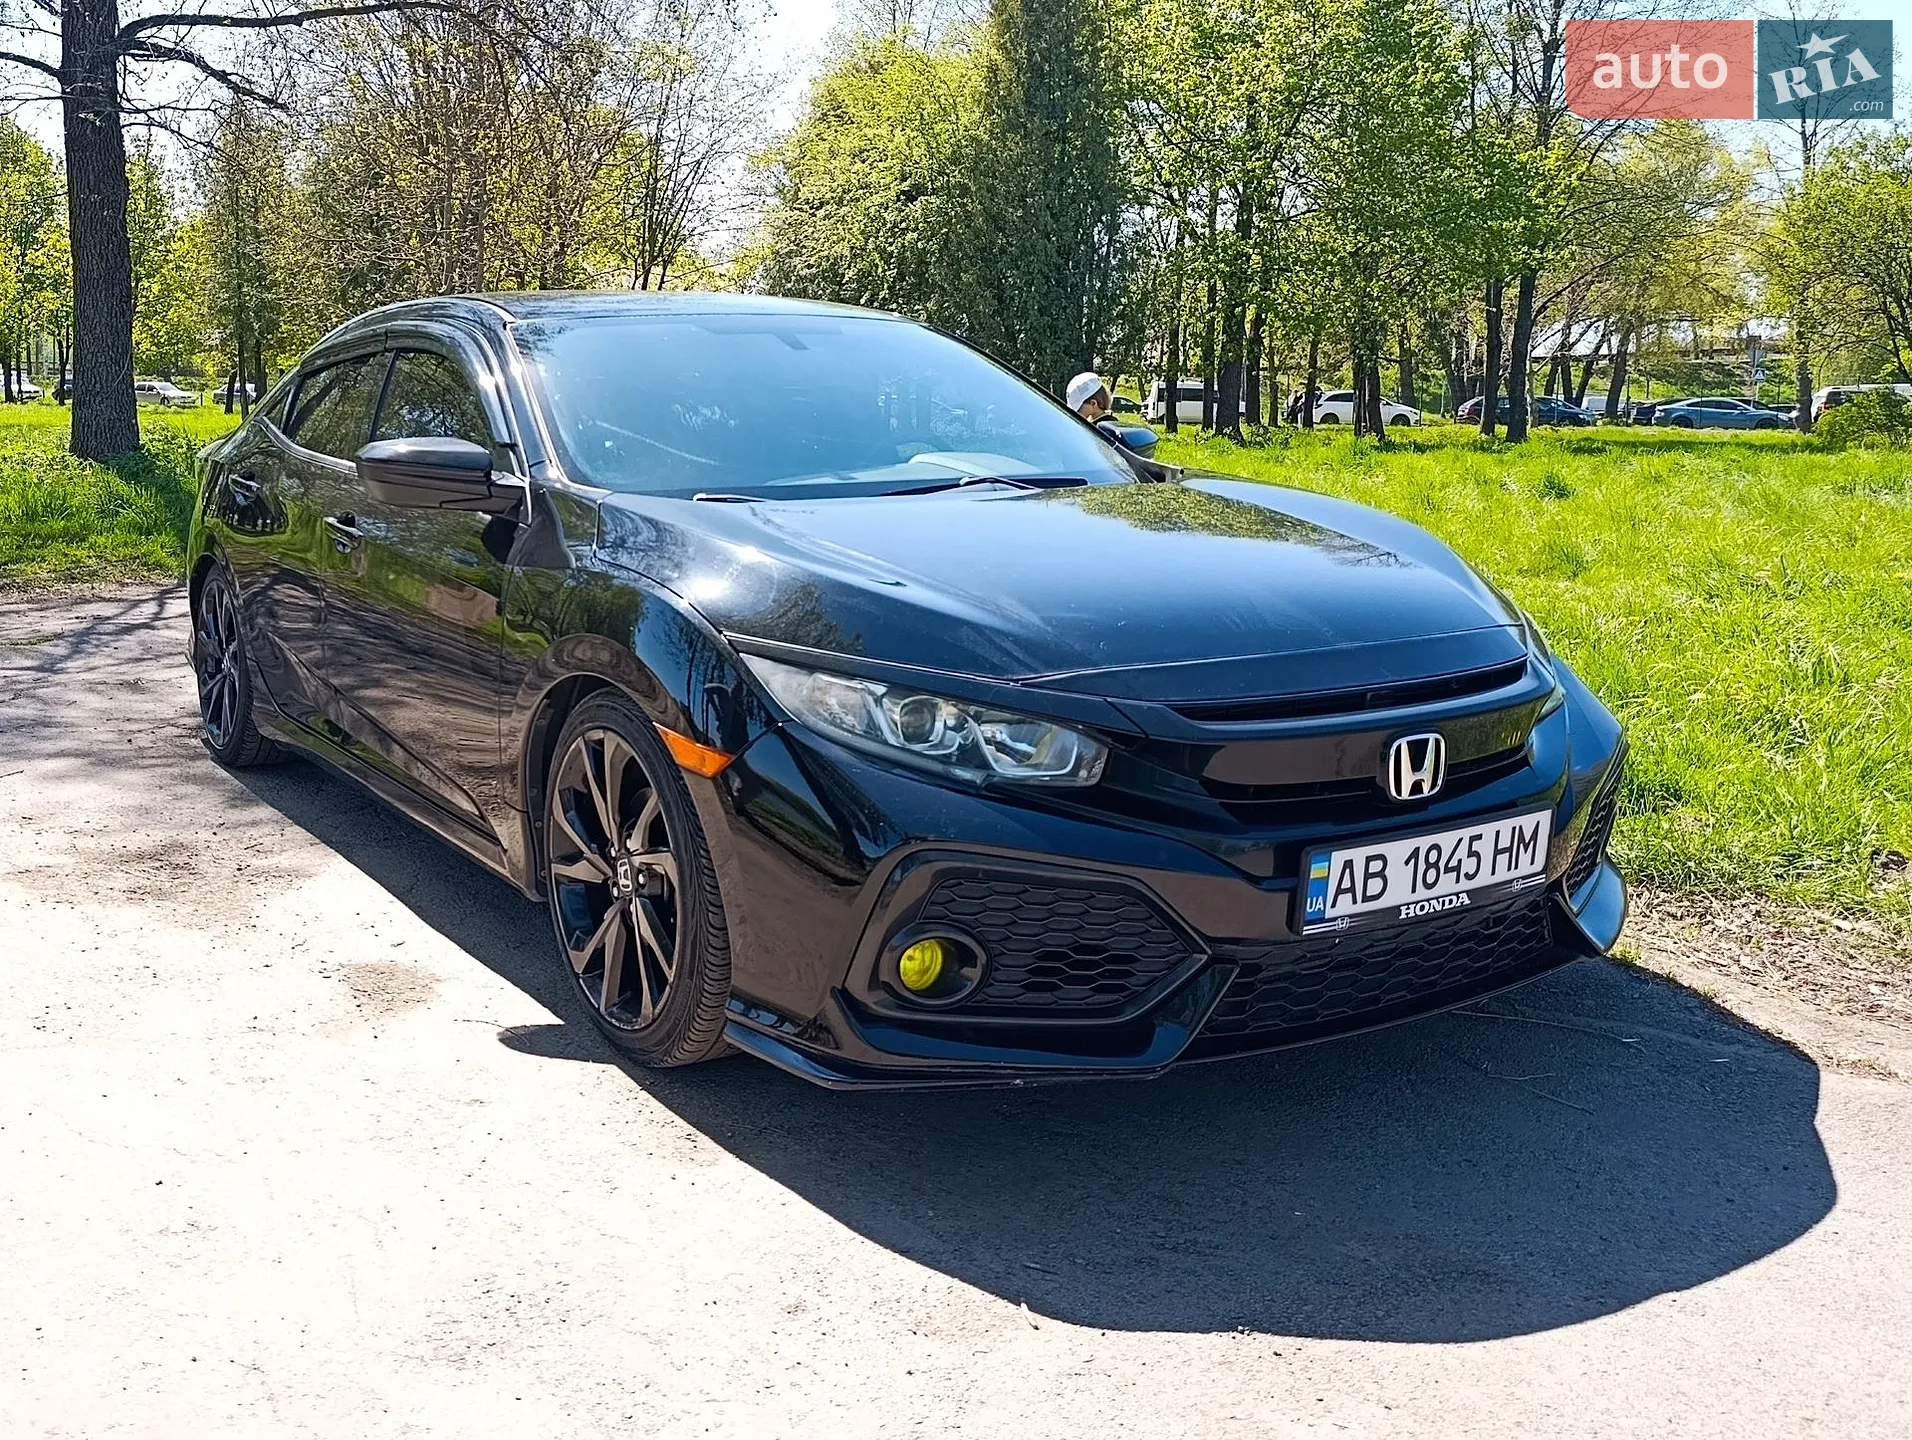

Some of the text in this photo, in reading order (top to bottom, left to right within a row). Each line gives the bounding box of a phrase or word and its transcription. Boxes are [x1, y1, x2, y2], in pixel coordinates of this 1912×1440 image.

[1330, 820, 1541, 910] AB 1845 HM
[1306, 896, 1325, 913] UA
[1399, 892, 1471, 919] HONDA
